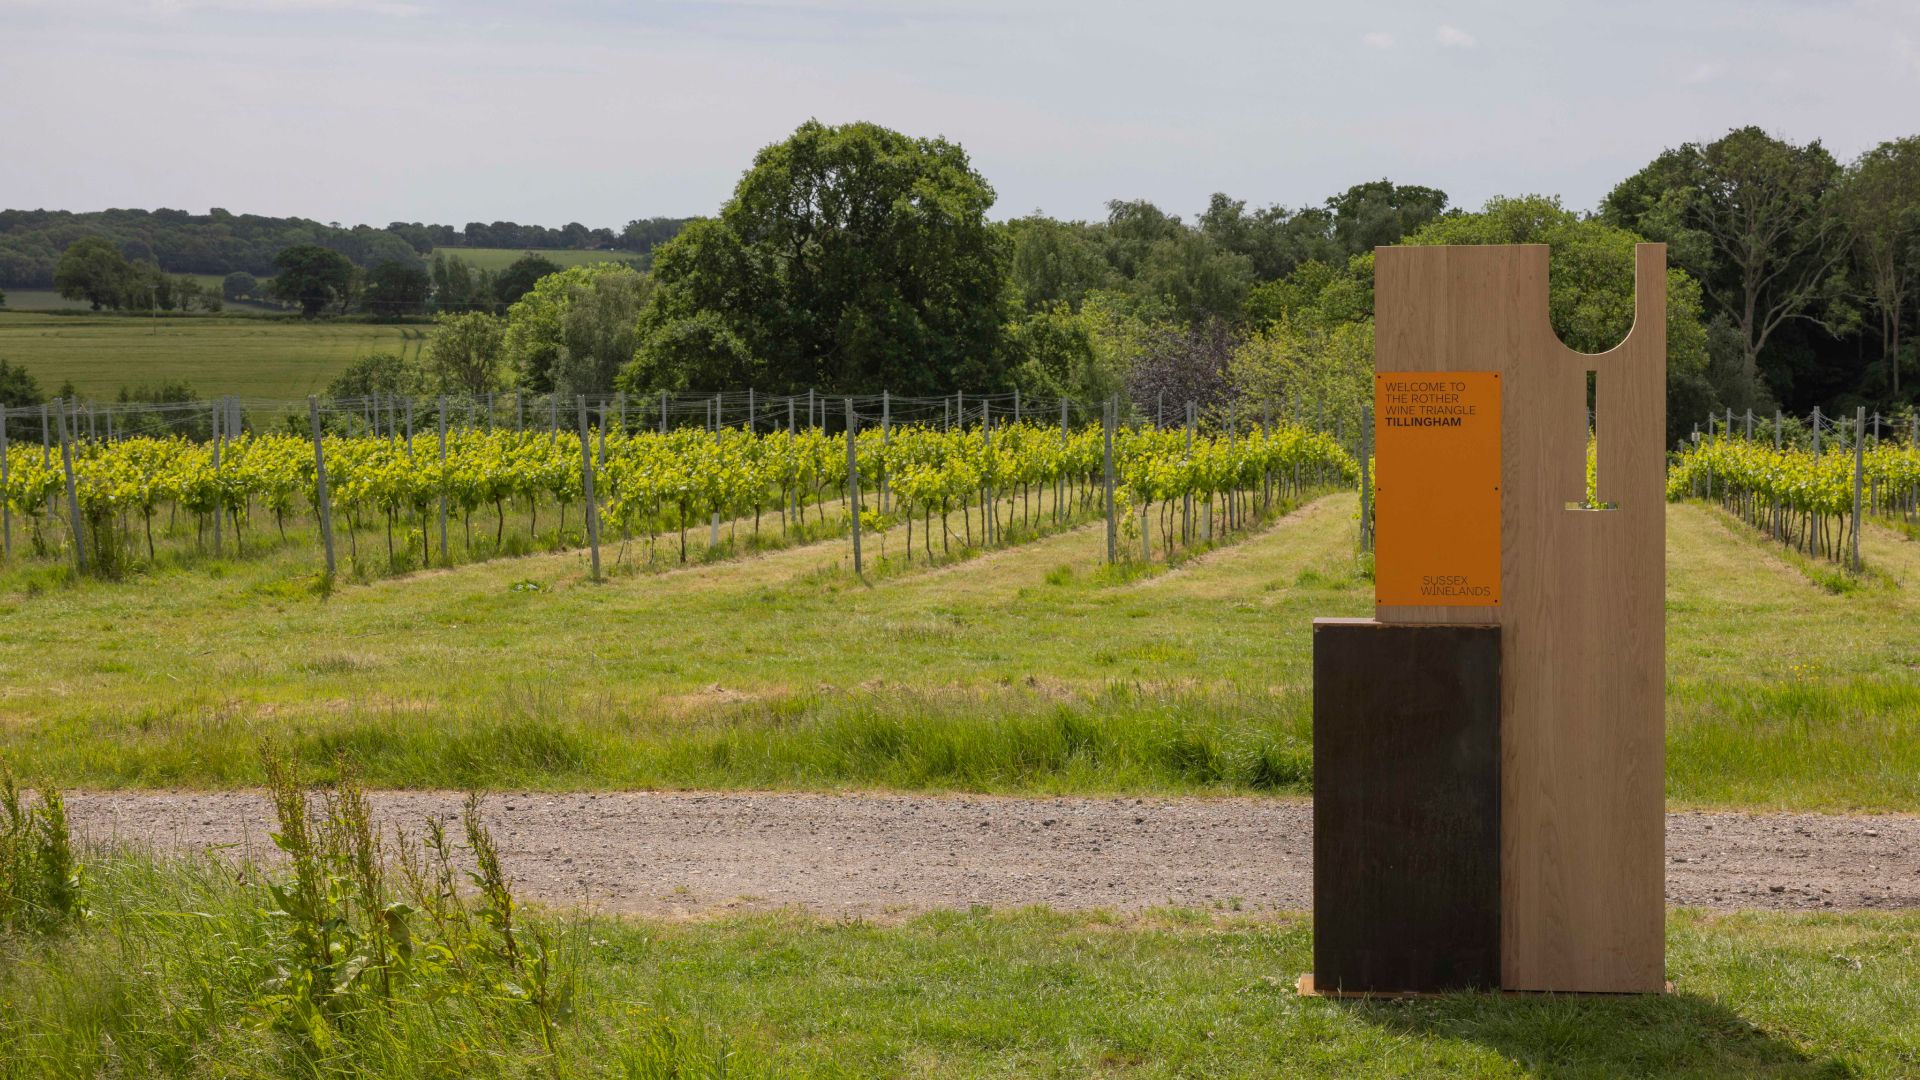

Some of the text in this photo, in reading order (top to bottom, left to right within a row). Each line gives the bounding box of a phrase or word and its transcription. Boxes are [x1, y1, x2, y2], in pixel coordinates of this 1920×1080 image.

[1385, 382, 1466, 392] WELCOME TO
[1385, 393, 1459, 404] THE ROTHER
[1385, 405, 1477, 415] WINE TRIANGLE
[1385, 417, 1462, 427] TILLINGHAM
[1423, 575, 1469, 585] SUSSEX
[1420, 586, 1491, 596] WINELANDS
